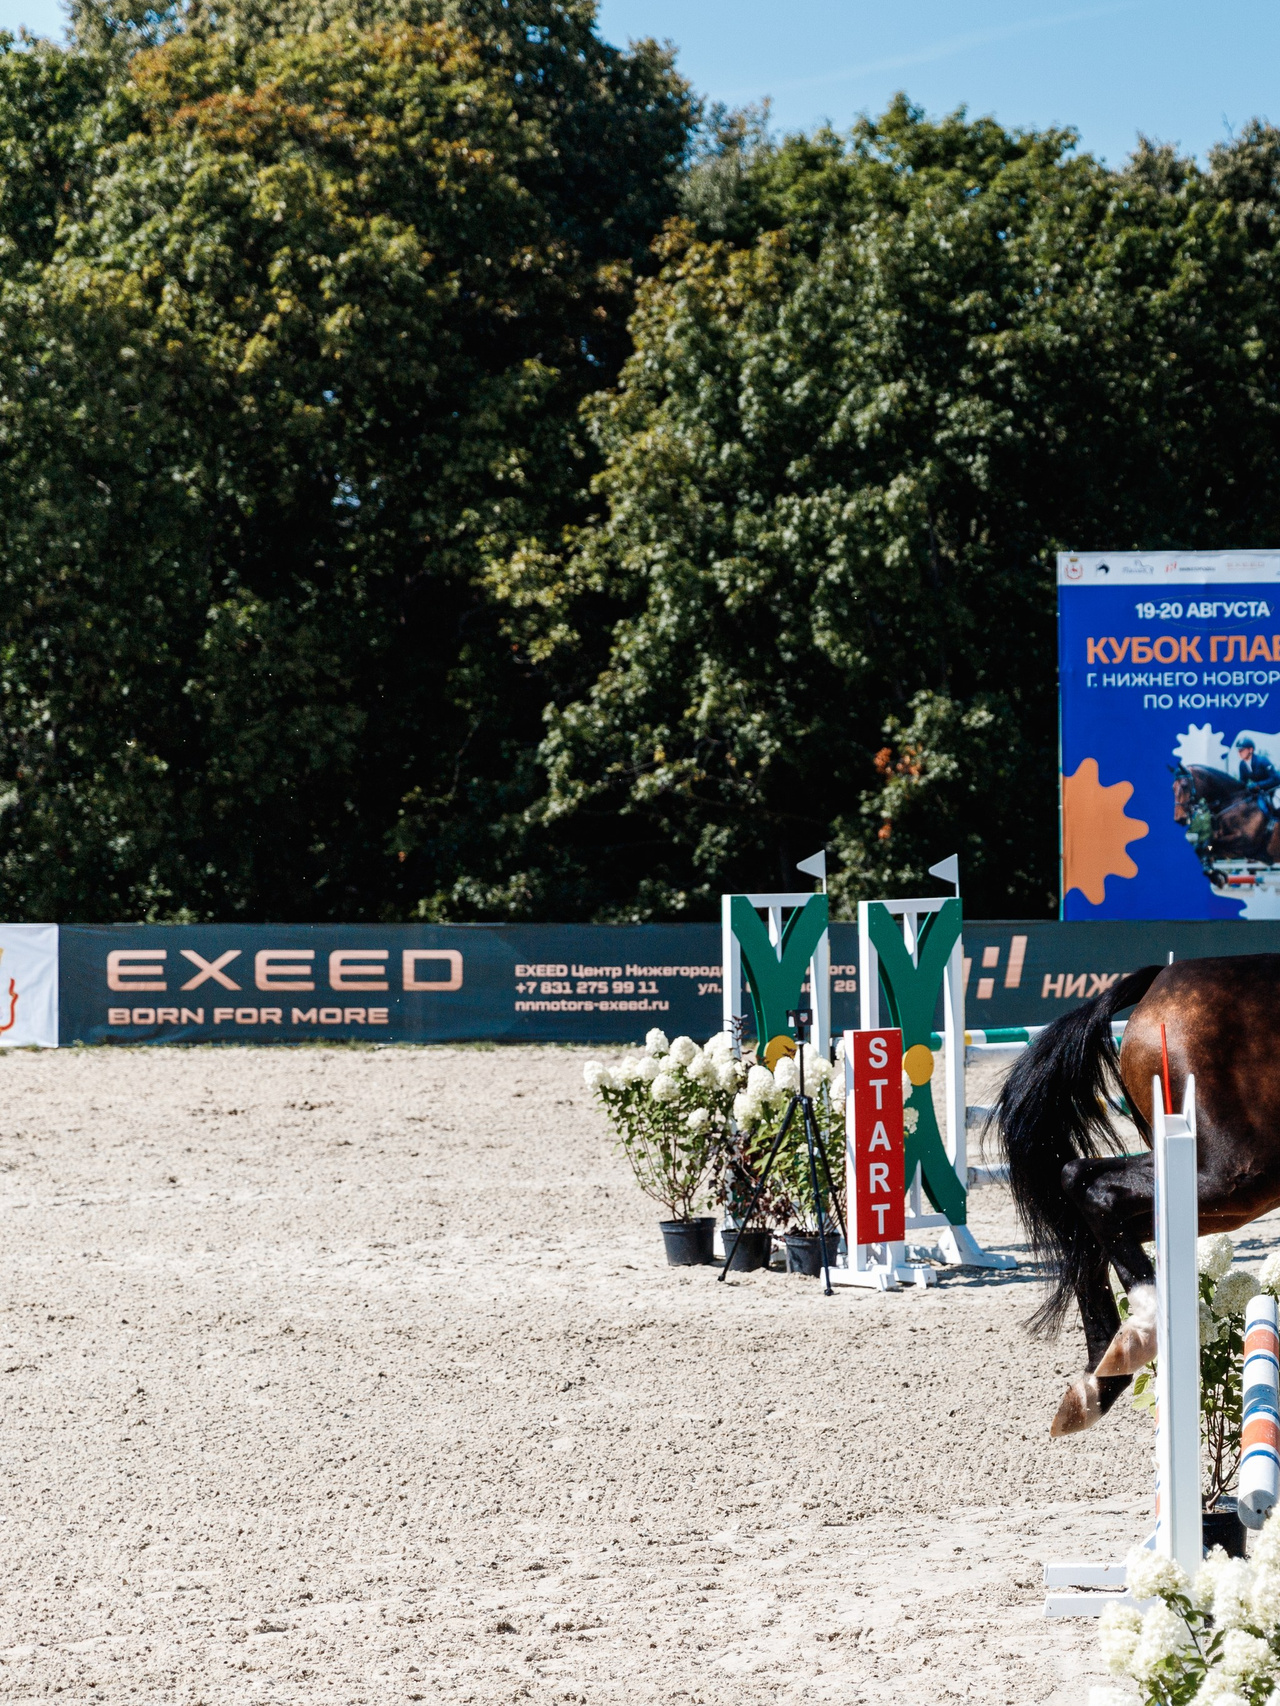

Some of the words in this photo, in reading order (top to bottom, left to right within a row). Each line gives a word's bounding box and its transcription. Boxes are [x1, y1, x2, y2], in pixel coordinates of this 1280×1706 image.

[1135, 602, 1183, 619] 19-20
[1187, 601, 1271, 618] АВГУСТА
[1087, 636, 1203, 664] КУБОК
[1087, 673, 1098, 687] Г.
[1103, 671, 1198, 687] НИЖНЕГО
[1144, 694, 1173, 709] ПО
[1179, 693, 1269, 709] КОНКУРУ
[106, 949, 464, 991] EXEED
[515, 964, 568, 977] EXEED
[571, 964, 622, 979] Центр
[515, 982, 537, 994] +7
[540, 981, 573, 994] 831
[576, 981, 608, 994] 275
[612, 981, 635, 994] 99
[637, 981, 659, 994] 11
[698, 982, 722, 996] ул.
[1041, 973, 1134, 999] НИЖ
[515, 999, 669, 1011] nnmotors-exeed.ru
[108, 1007, 204, 1025] BORN
[213, 1007, 283, 1025] FOR
[292, 1007, 389, 1025] MORE
[868, 1037, 891, 1235] START
